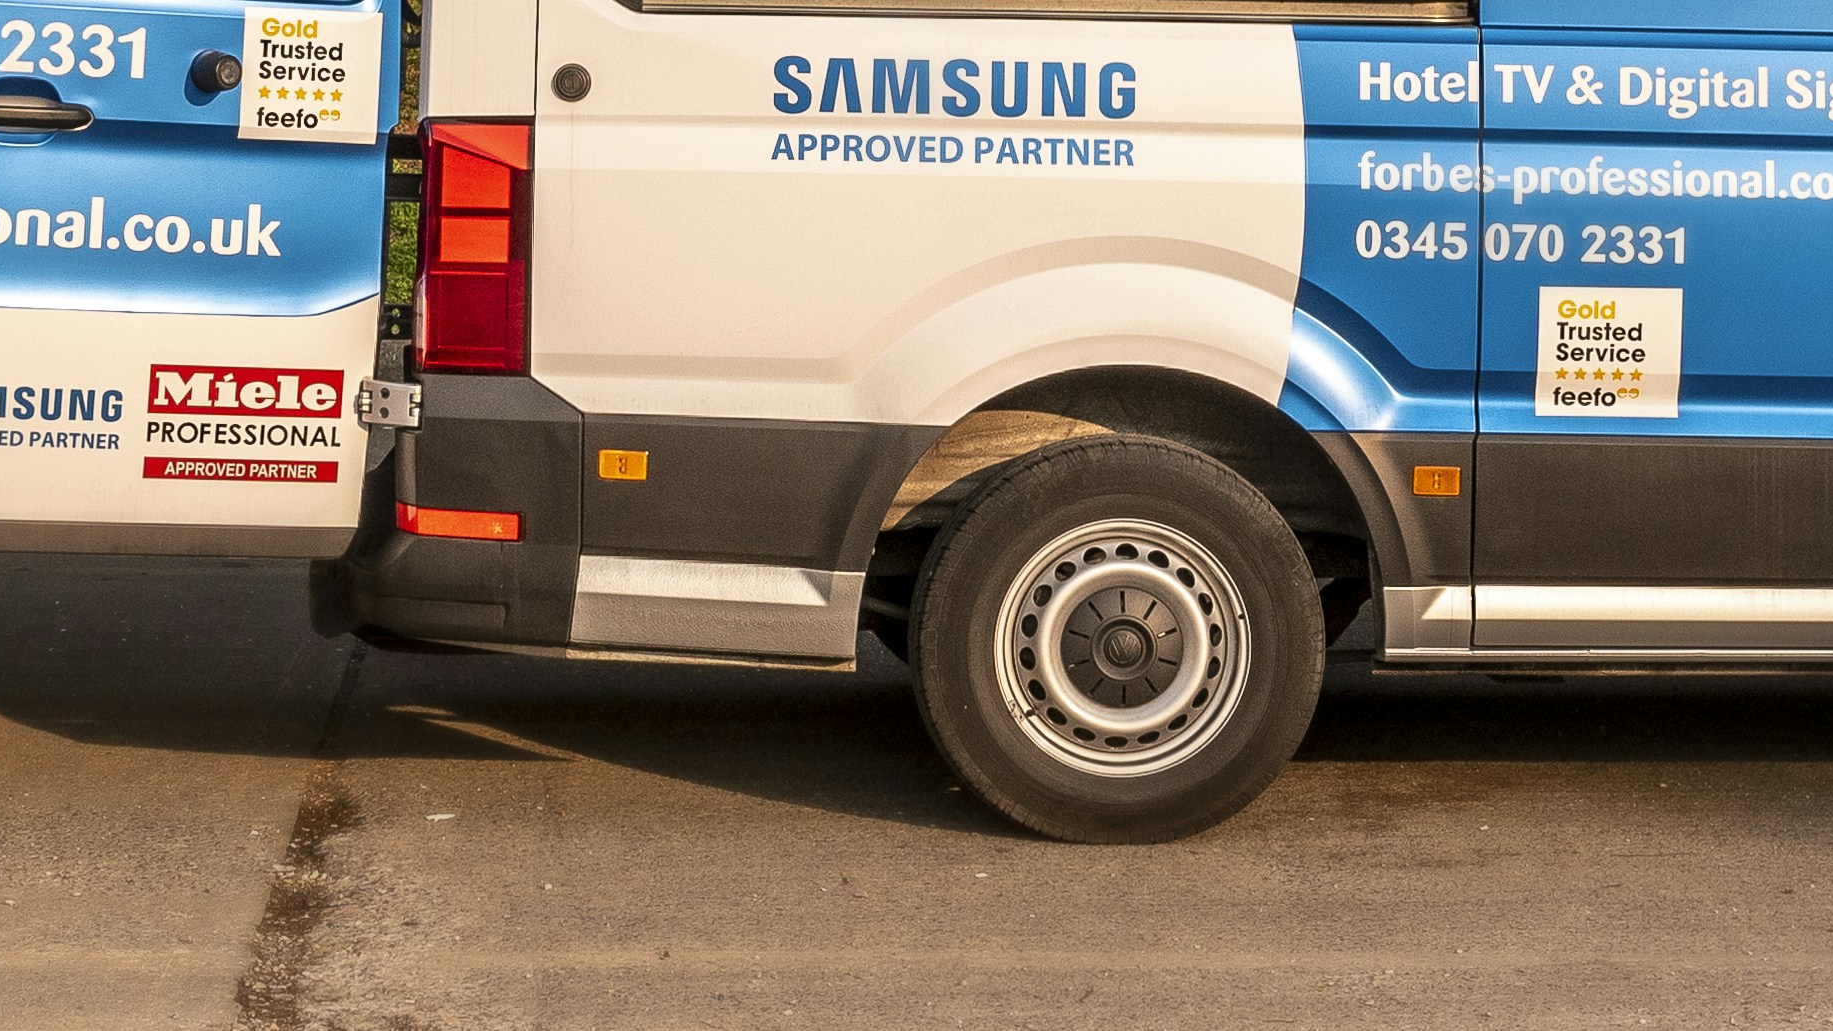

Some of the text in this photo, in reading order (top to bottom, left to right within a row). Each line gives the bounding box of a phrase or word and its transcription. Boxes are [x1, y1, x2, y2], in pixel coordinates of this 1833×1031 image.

[262, 17, 318, 39] Gold
[259, 39, 343, 62] Trusted
[258, 60, 346, 83] Service
[773, 54, 1138, 119] SAMSUNG
[1358, 61, 1479, 103] Hotel
[1494, 63, 1555, 106] TV
[1566, 65, 1604, 106] &
[1618, 63, 1769, 120] Digital
[256, 107, 317, 130] feefo
[771, 133, 1135, 167] APPROVED PARTNER
[1354, 219, 1687, 265] 0345 070 2331
[1557, 299, 1616, 321] Gold
[1556, 320, 1643, 343] Trusted
[1555, 341, 1646, 364] Service
[153, 370, 337, 411] Miele
[1552, 385, 1616, 408] feefo
[29, 430, 120, 450] PARTNER
[145, 421, 341, 448] PROFESSIONAL
[164, 461, 317, 479] APPROVED PARTNER
